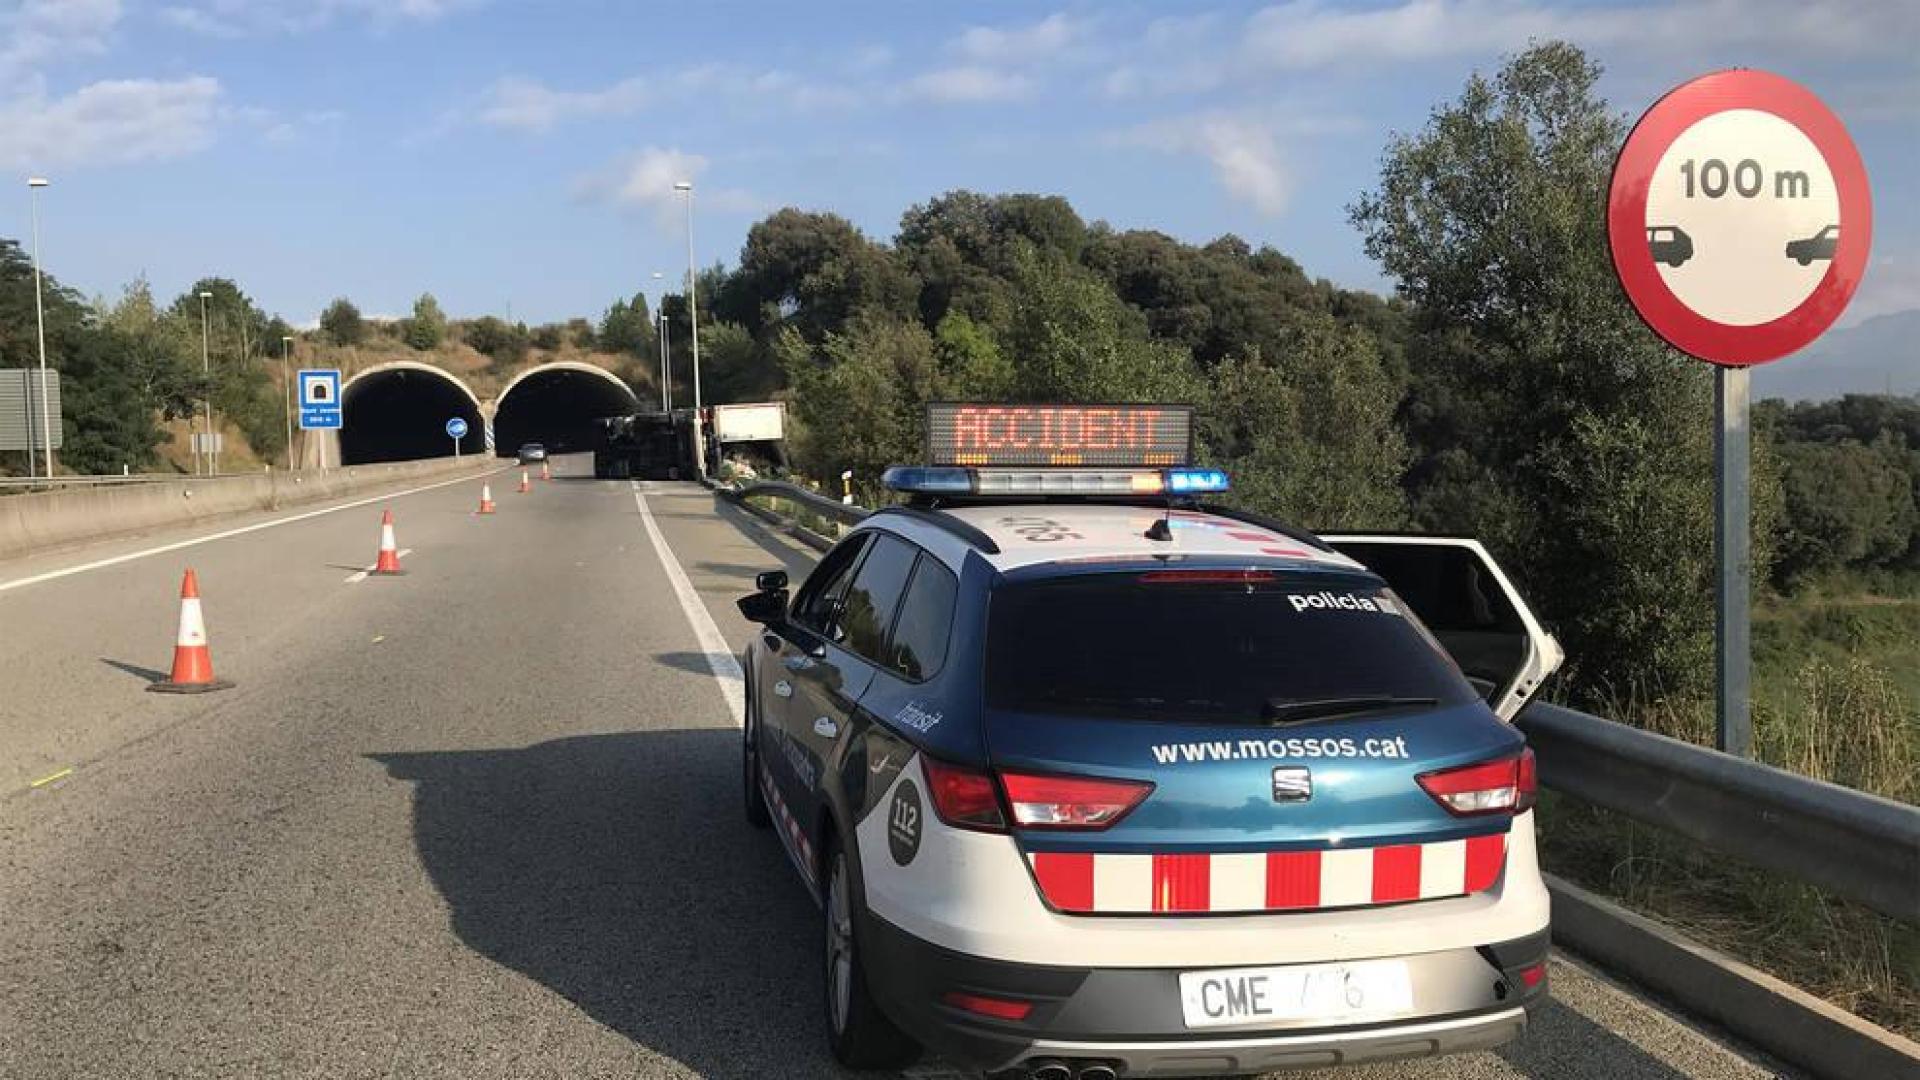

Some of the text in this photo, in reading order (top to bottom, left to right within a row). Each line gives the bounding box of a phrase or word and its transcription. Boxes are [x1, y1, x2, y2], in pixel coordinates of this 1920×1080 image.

[1680, 158, 1810, 199] 100 m
[955, 407, 1161, 448] ACCIDENT
[1287, 590, 1378, 612] policia
[1151, 735, 1410, 764] www.mossos.cat
[893, 797, 916, 836] 112
[1201, 975, 1273, 1017] CME
